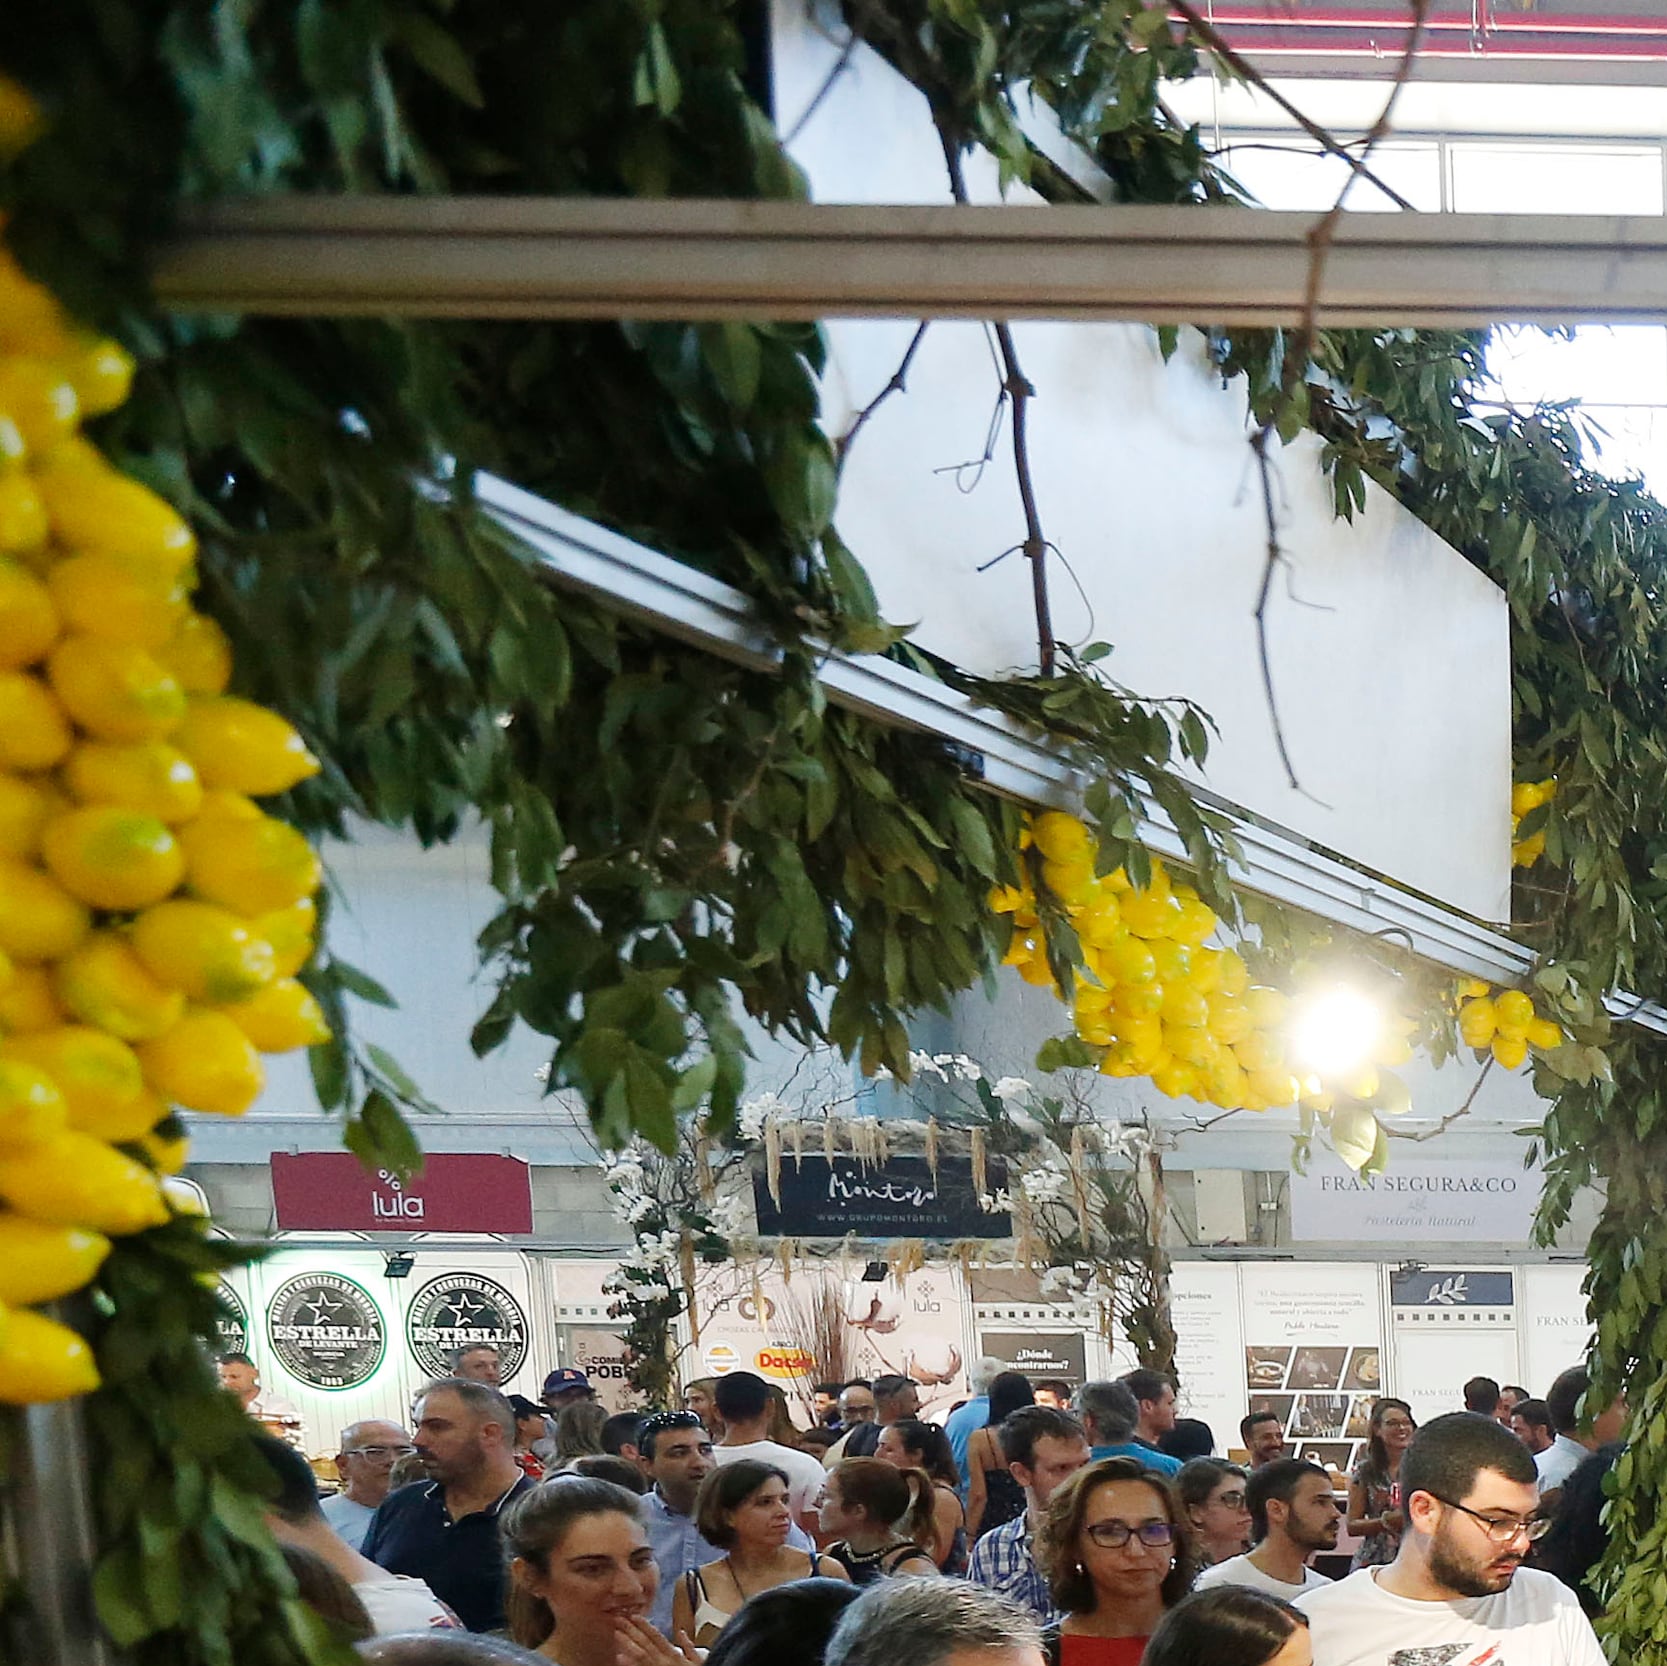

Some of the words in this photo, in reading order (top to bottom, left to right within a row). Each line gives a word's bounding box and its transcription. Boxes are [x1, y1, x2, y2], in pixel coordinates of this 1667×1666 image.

[1320, 1175, 1376, 1192] FRAN
[1383, 1176, 1517, 1194] SEGURA&CO
[372, 1190, 425, 1218] lula
[914, 1297, 941, 1313] lula
[1536, 1316, 1570, 1326] FRAN
[271, 1325, 381, 1341] ESTRELLA
[412, 1327, 522, 1343] ESTRELLA
[298, 1340, 313, 1348] DE
[313, 1340, 359, 1349] LEVANTE
